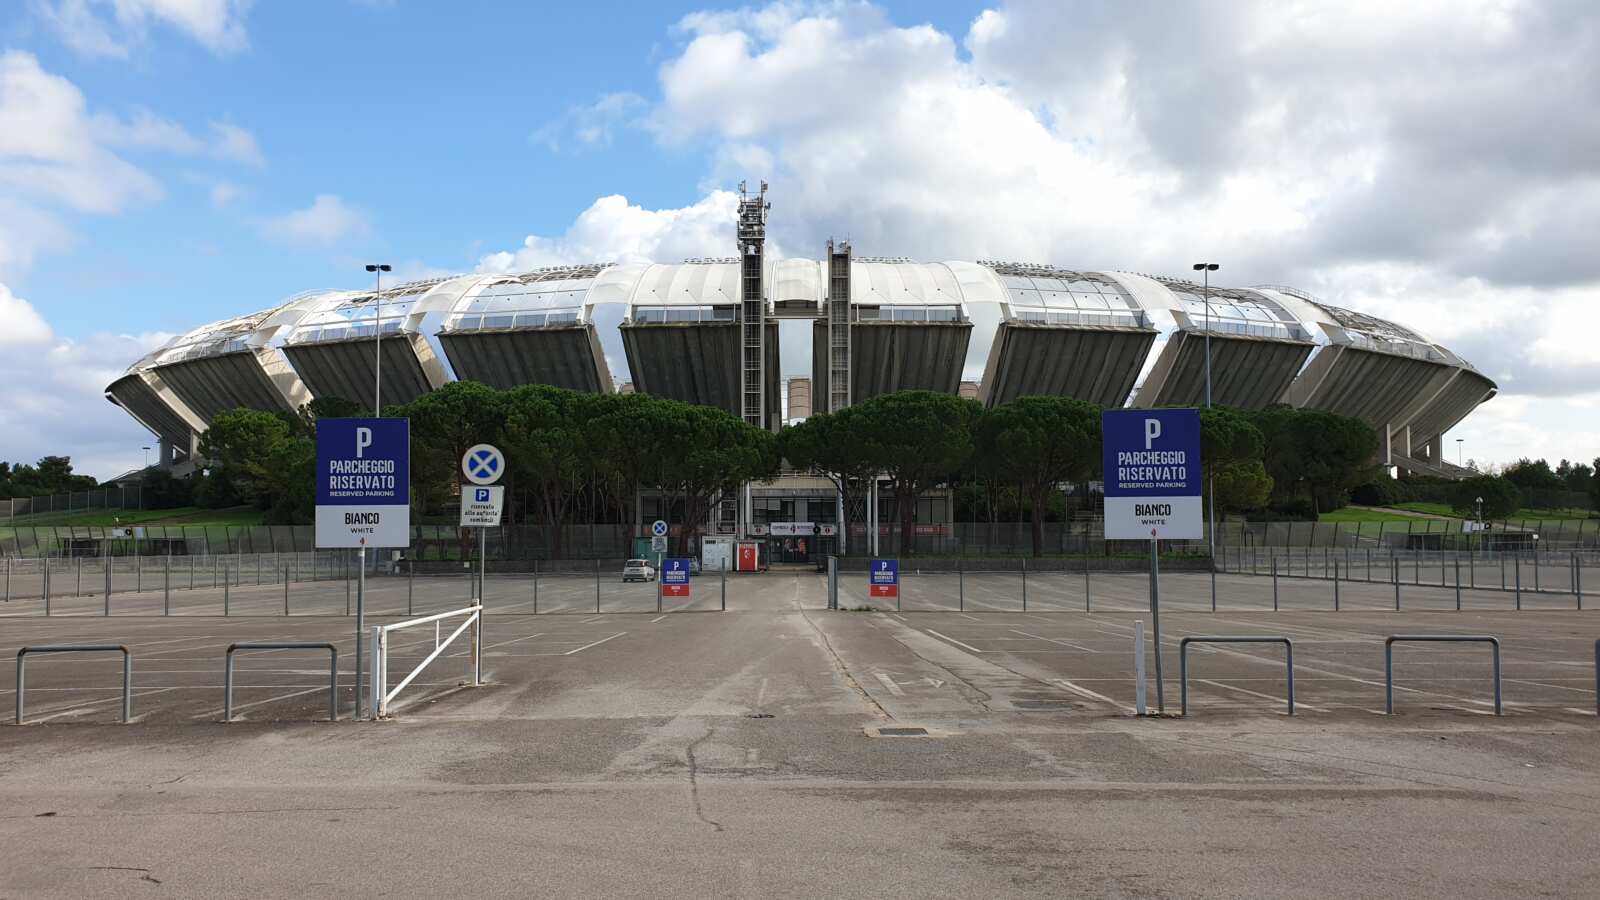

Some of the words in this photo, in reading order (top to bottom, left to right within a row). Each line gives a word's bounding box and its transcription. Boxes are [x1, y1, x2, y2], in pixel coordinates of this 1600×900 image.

[1144, 418, 1161, 450] P
[356, 427, 373, 458] P
[1118, 451, 1186, 465] PARCHEGGIO
[329, 460, 395, 474] PARCHEGGIO
[1118, 466, 1187, 481] RISERVATO
[329, 475, 395, 489] RISERVATO
[478, 490, 487, 501] P
[1135, 504, 1172, 516] BIANCO
[344, 512, 380, 525] BIANCO
[673, 561, 680, 571] P
[881, 561, 888, 571] P
